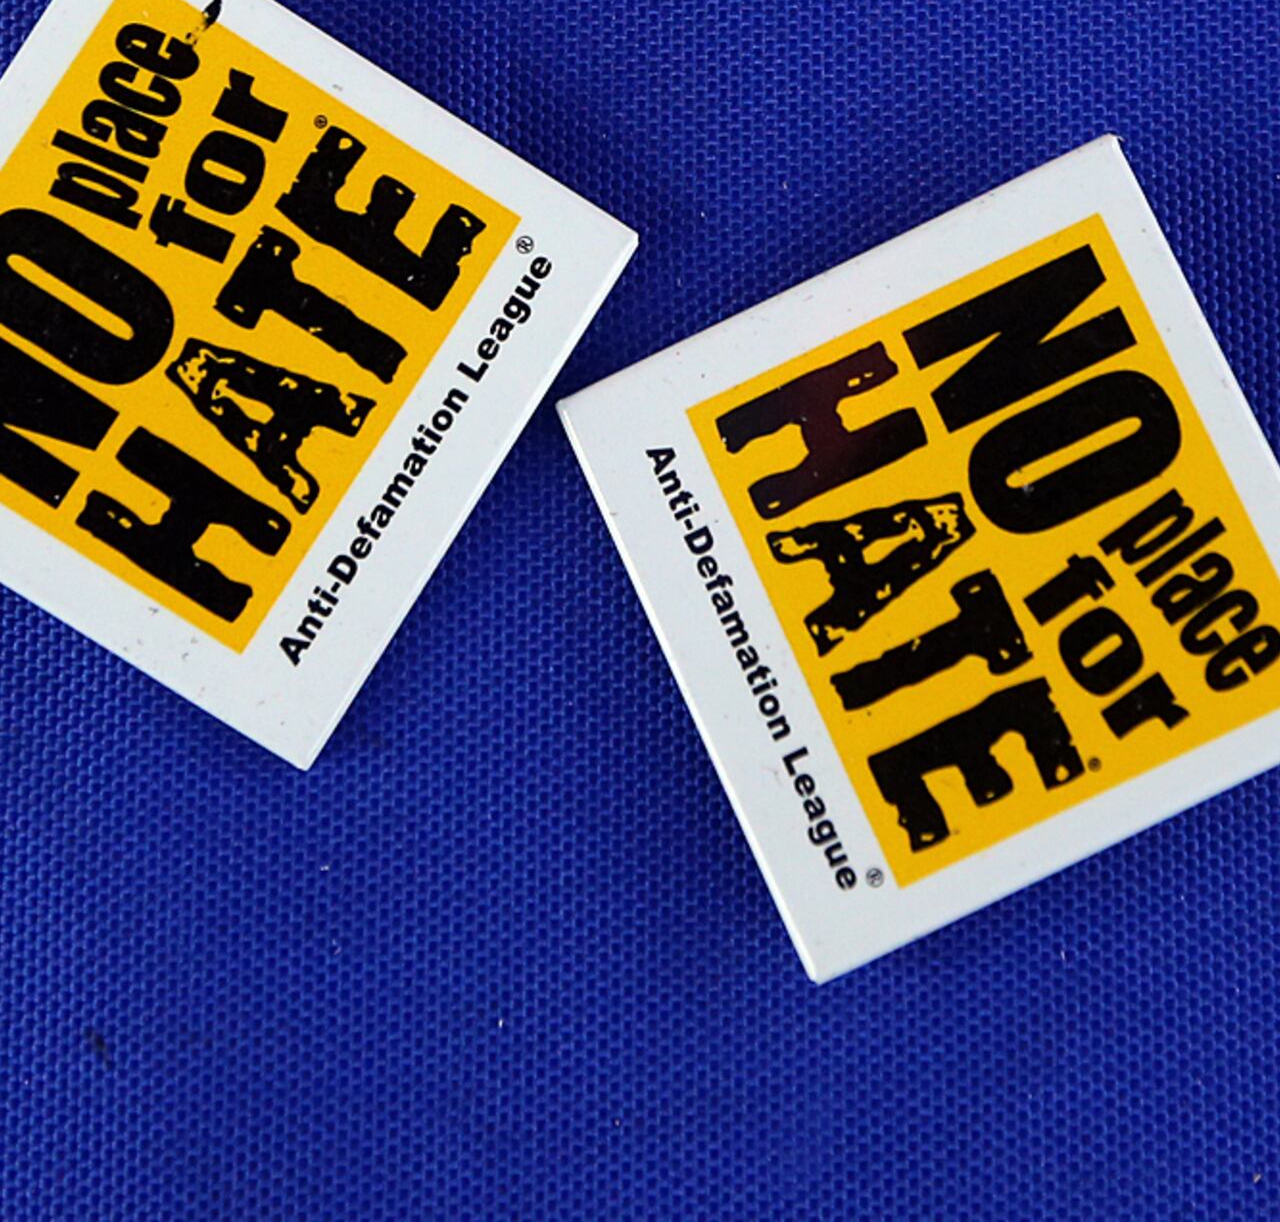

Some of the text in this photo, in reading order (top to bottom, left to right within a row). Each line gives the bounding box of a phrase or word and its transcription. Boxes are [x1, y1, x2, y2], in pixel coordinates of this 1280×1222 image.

[49, 22, 202, 230] place
[149, 68, 289, 264] for
[902, 243, 1183, 535] NO
[278, 383, 469, 667] Anti-Defamation
[645, 444, 790, 742] Anti-Defamation
[1023, 553, 1190, 741] for
